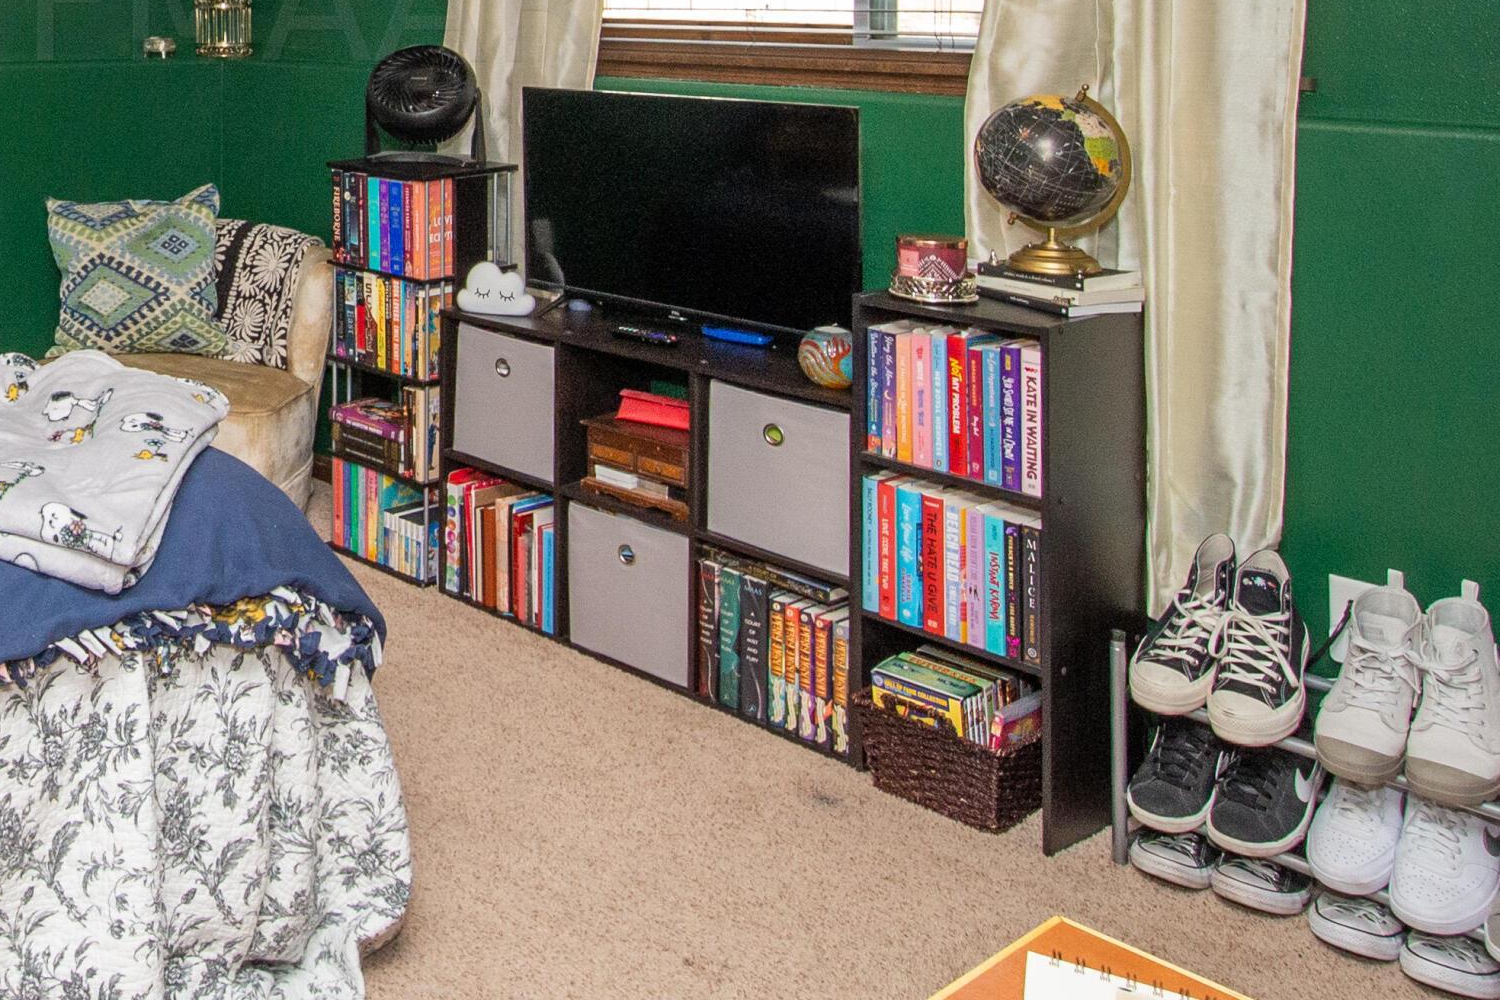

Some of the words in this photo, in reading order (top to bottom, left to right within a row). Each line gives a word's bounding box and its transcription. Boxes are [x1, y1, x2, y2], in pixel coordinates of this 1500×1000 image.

[333, 187, 342, 242] FIREBORNE
[346, 310, 354, 335] East
[883, 336, 895, 354] Hang
[949, 358, 964, 382] NOT
[952, 376, 961, 392] MY
[1026, 376, 1037, 408] KATE
[951, 392, 961, 434] PROBLEM
[1026, 409, 1037, 422] IN
[1026, 425, 1038, 481] WAITING
[901, 503, 912, 522] Love
[927, 512, 937, 535] THE
[900, 522, 913, 544] Your
[945, 511, 960, 550] BEACH
[900, 545, 913, 563] Life
[927, 538, 938, 570] HATE
[945, 550, 960, 583] READ
[927, 572, 937, 582] U
[988, 551, 1001, 587] INSTANT
[1025, 539, 1037, 609] MALICE
[927, 584, 938, 613] GIVE
[988, 587, 1001, 620] KARMA
